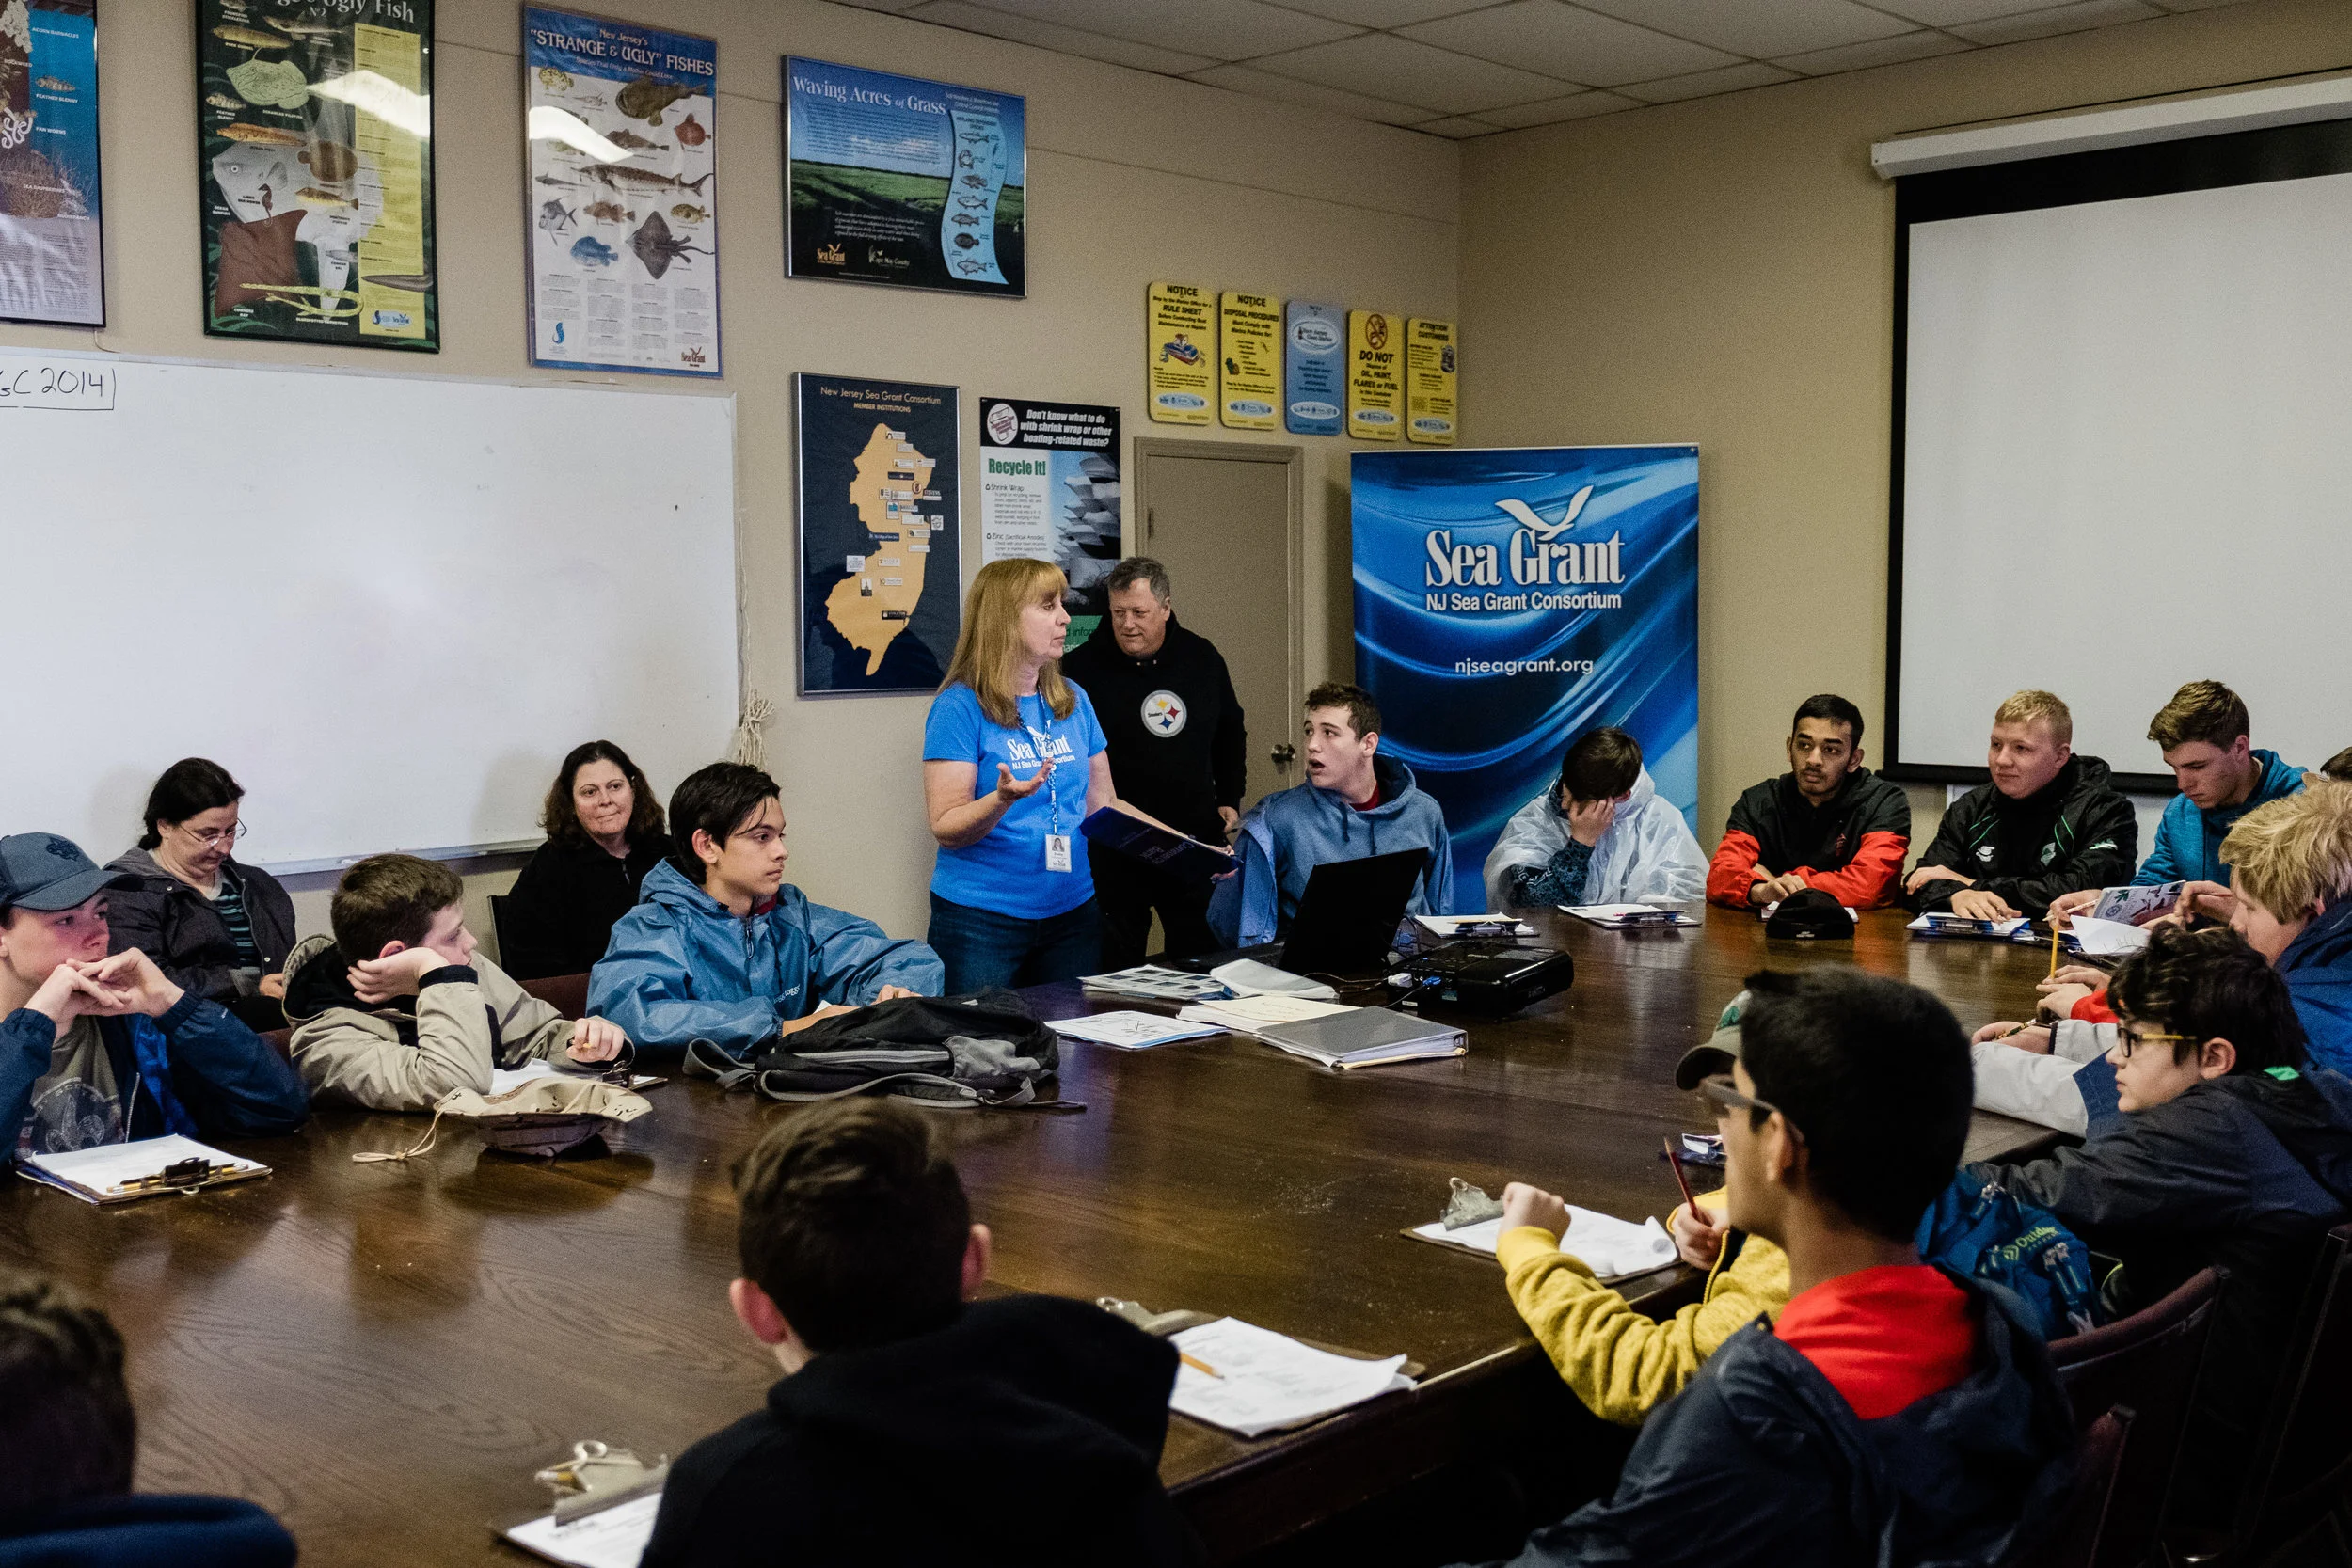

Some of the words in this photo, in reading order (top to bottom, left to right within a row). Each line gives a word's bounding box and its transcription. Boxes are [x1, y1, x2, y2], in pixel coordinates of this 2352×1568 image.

[375, 0, 414, 24] Fish
[599, 29, 615, 40] New
[617, 32, 648, 45] Jersey's
[531, 29, 607, 56] "STRANGE
[609, 46, 617, 56] &
[621, 47, 662, 66] UGLY"
[666, 55, 715, 76] FISHES
[793, 76, 847, 103] Waving
[850, 87, 892, 107] Acres
[895, 97, 905, 109] of
[907, 95, 946, 116] Grass
[1167, 285, 1198, 297] NOTICE
[1237, 294, 1267, 307] NOTICE
[1163, 305, 1180, 313] RULE
[1182, 307, 1202, 315] SHEET
[1224, 309, 1247, 318] DISPOSAL
[1359, 350, 1373, 361] DO
[1375, 352, 1394, 363] NOT
[40, 367, 103, 397] 2014
[1353, 378, 1375, 388] FLARES
[1384, 382, 1398, 390] FUEL
[820, 386, 838, 396] New
[840, 387, 864, 400] Jersey
[866, 389, 880, 400] Sea
[882, 391, 903, 402] Grant
[904, 393, 941, 404] Consortium
[1026, 408, 1046, 420] Don't
[1047, 410, 1068, 421] know
[1068, 411, 1087, 422] what
[1088, 412, 1095, 422] to
[1096, 413, 1105, 423] do
[1020, 421, 1038, 431] with
[1039, 422, 1062, 433] shrink
[1063, 424, 1082, 436] wrap
[1083, 425, 1091, 434] or
[1091, 425, 1112, 436] other
[1024, 434, 1082, 446] boating-related
[1082, 436, 1109, 447] waste?
[988, 458, 1032, 477] Recycle
[1035, 460, 1046, 476] It!
[1009, 484, 1025, 493] Wrap
[1425, 529, 1502, 587] Sea
[1509, 528, 1625, 587] Grant
[1426, 593, 1447, 611] NJ
[1451, 591, 1480, 611] Sea
[1484, 592, 1527, 611] Grant
[1531, 590, 1622, 610] Consortium
[1455, 658, 1594, 676] njseagrant.org
[1007, 738, 1036, 761] Sea
[1012, 761, 1022, 770] NJ
[1022, 760, 1032, 768] Sea
